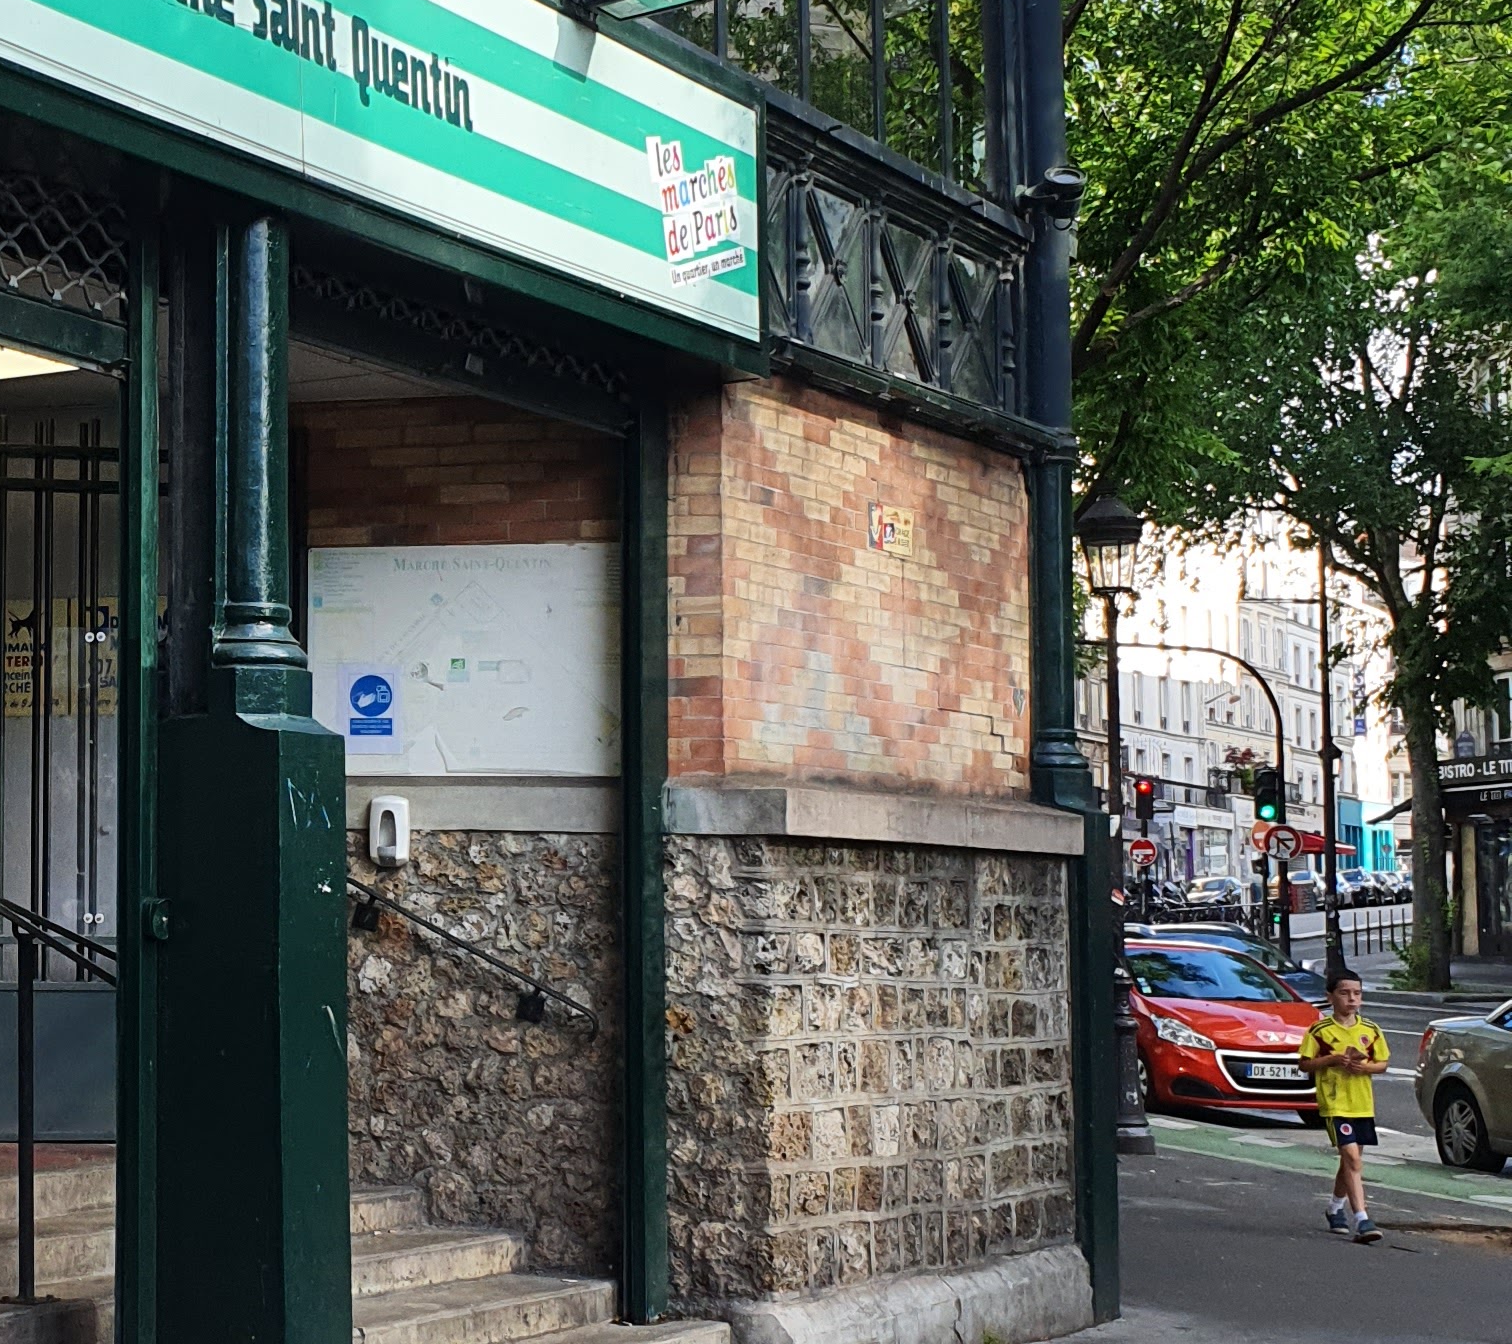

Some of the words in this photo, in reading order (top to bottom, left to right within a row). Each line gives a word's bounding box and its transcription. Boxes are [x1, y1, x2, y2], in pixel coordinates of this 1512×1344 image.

[350, 15, 473, 133] Quentin
[655, 142, 681, 177] les
[661, 158, 735, 213] marchés
[668, 219, 689, 256] de
[692, 199, 738, 246] Paris
[1482, 760, 1496, 775] LE
